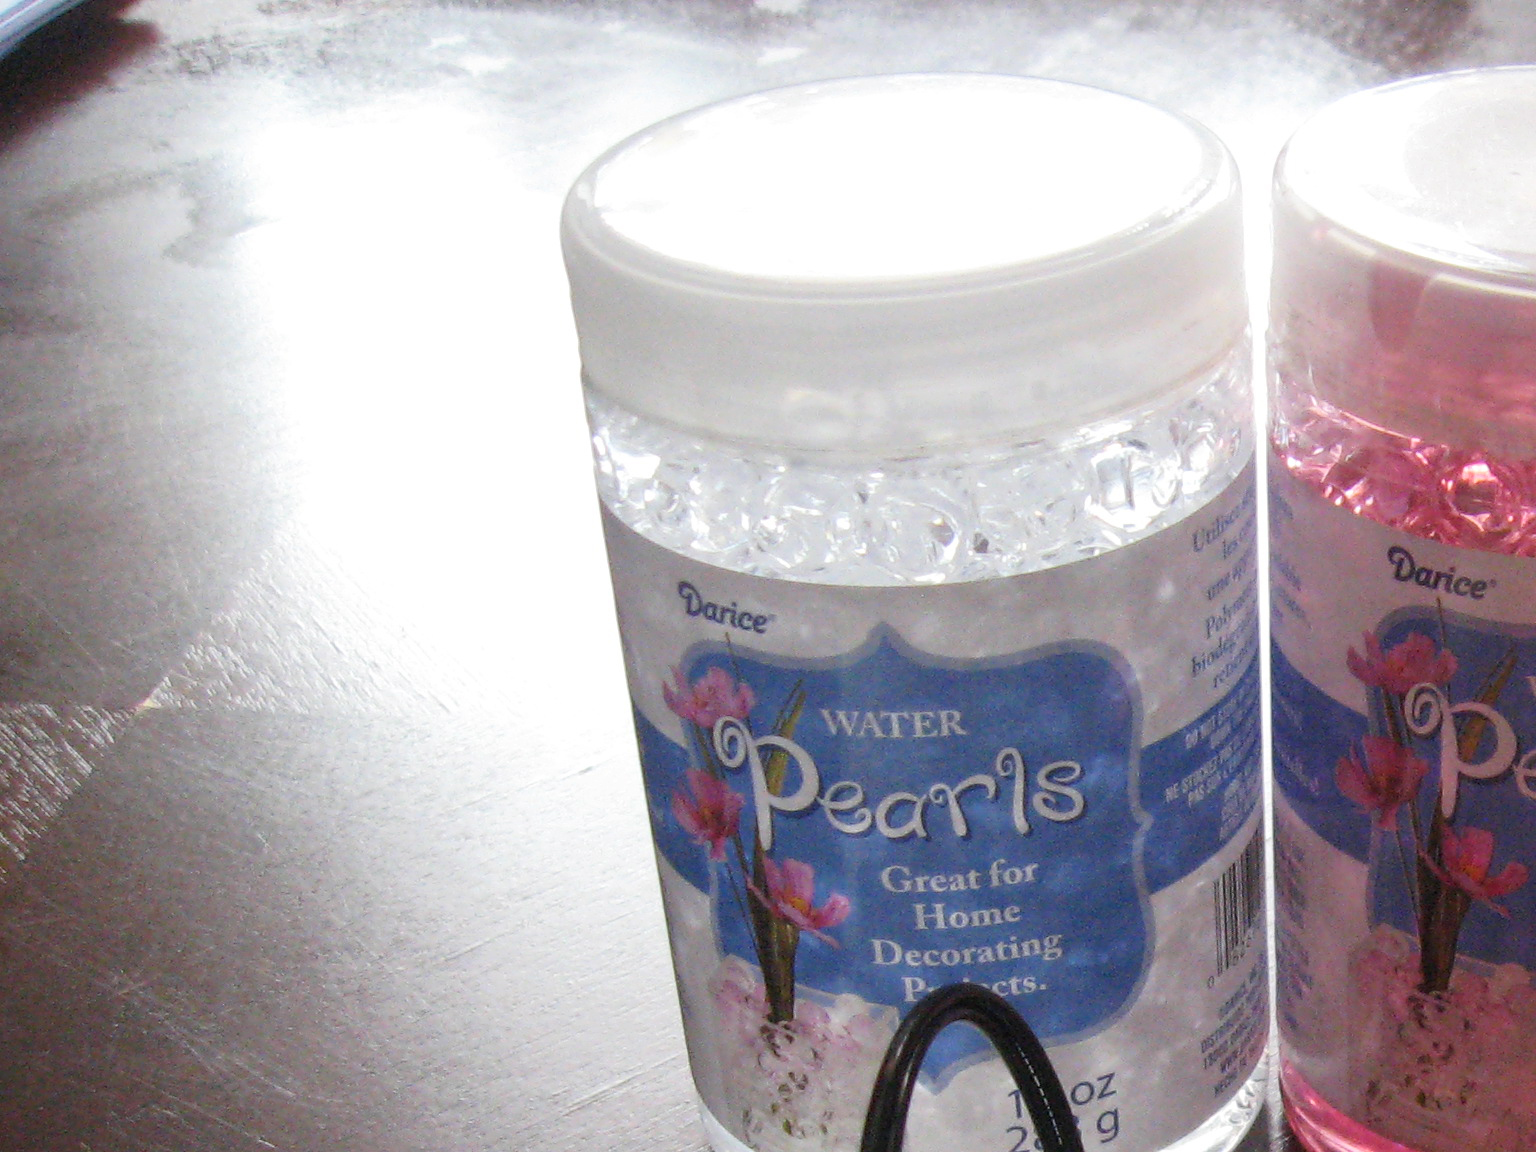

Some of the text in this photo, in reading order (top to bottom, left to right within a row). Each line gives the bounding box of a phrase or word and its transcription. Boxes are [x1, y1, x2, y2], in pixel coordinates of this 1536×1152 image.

[1386, 546, 1488, 600] Darice
[678, 580, 768, 634] Darice
[820, 708, 968, 739] WATER
[713, 715, 1087, 852] Pearls
[881, 859, 1040, 893] Great for
[913, 903, 1022, 931] Home
[870, 934, 1064, 967] Decorating
[901, 976, 1047, 1003] Pcts.
[1071, 1072, 1116, 1105] oz
[1097, 1108, 1119, 1143] g
